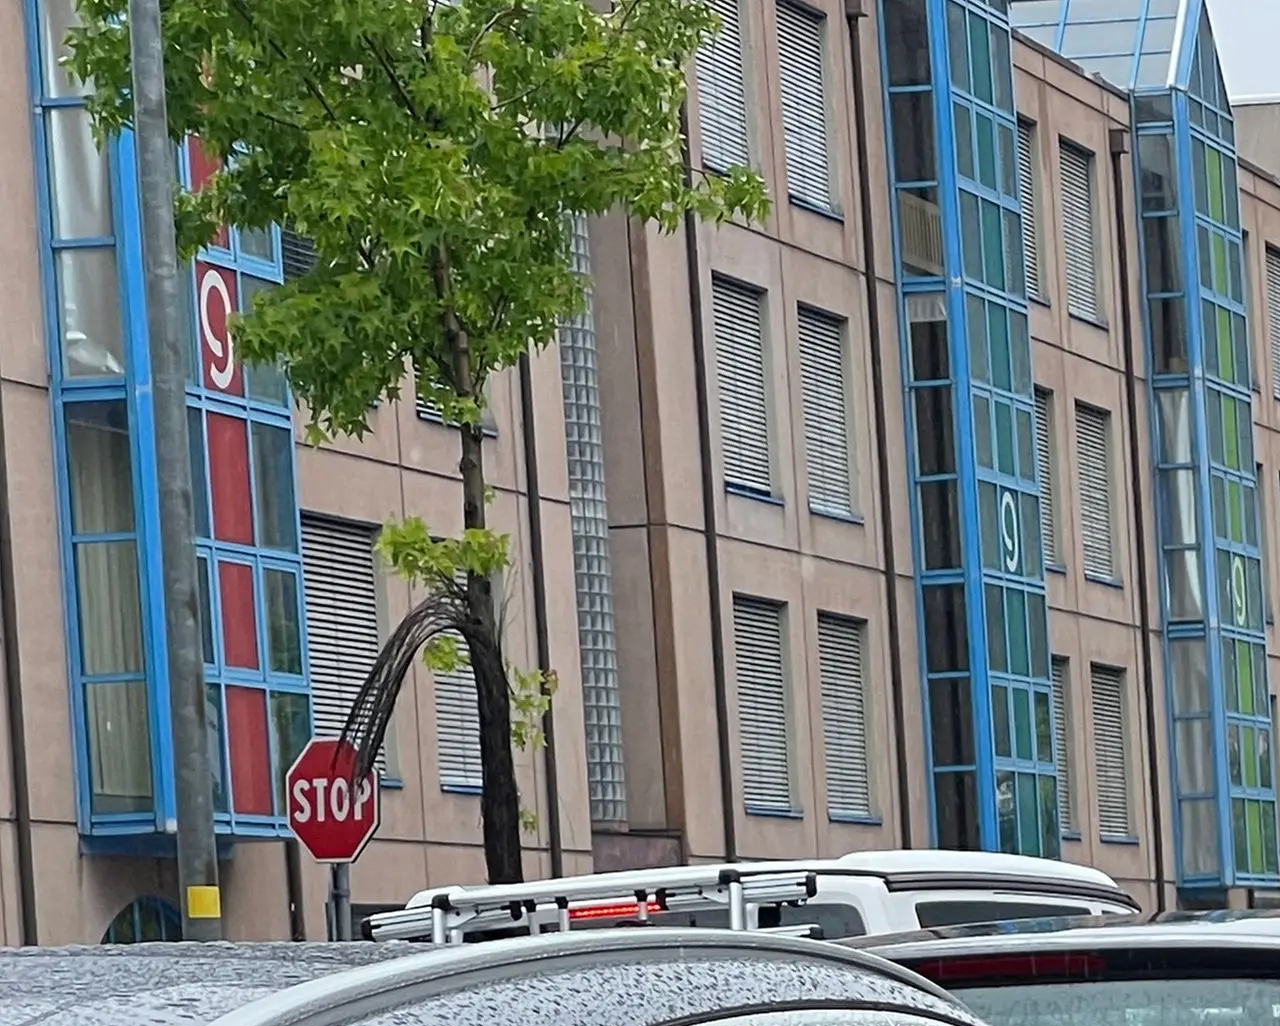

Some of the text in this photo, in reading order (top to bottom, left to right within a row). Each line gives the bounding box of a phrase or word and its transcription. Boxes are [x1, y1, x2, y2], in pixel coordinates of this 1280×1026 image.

[200, 269, 234, 389] 9
[1001, 491, 1019, 572] 9
[1232, 555, 1246, 626] 9
[293, 777, 371, 823] STOP
